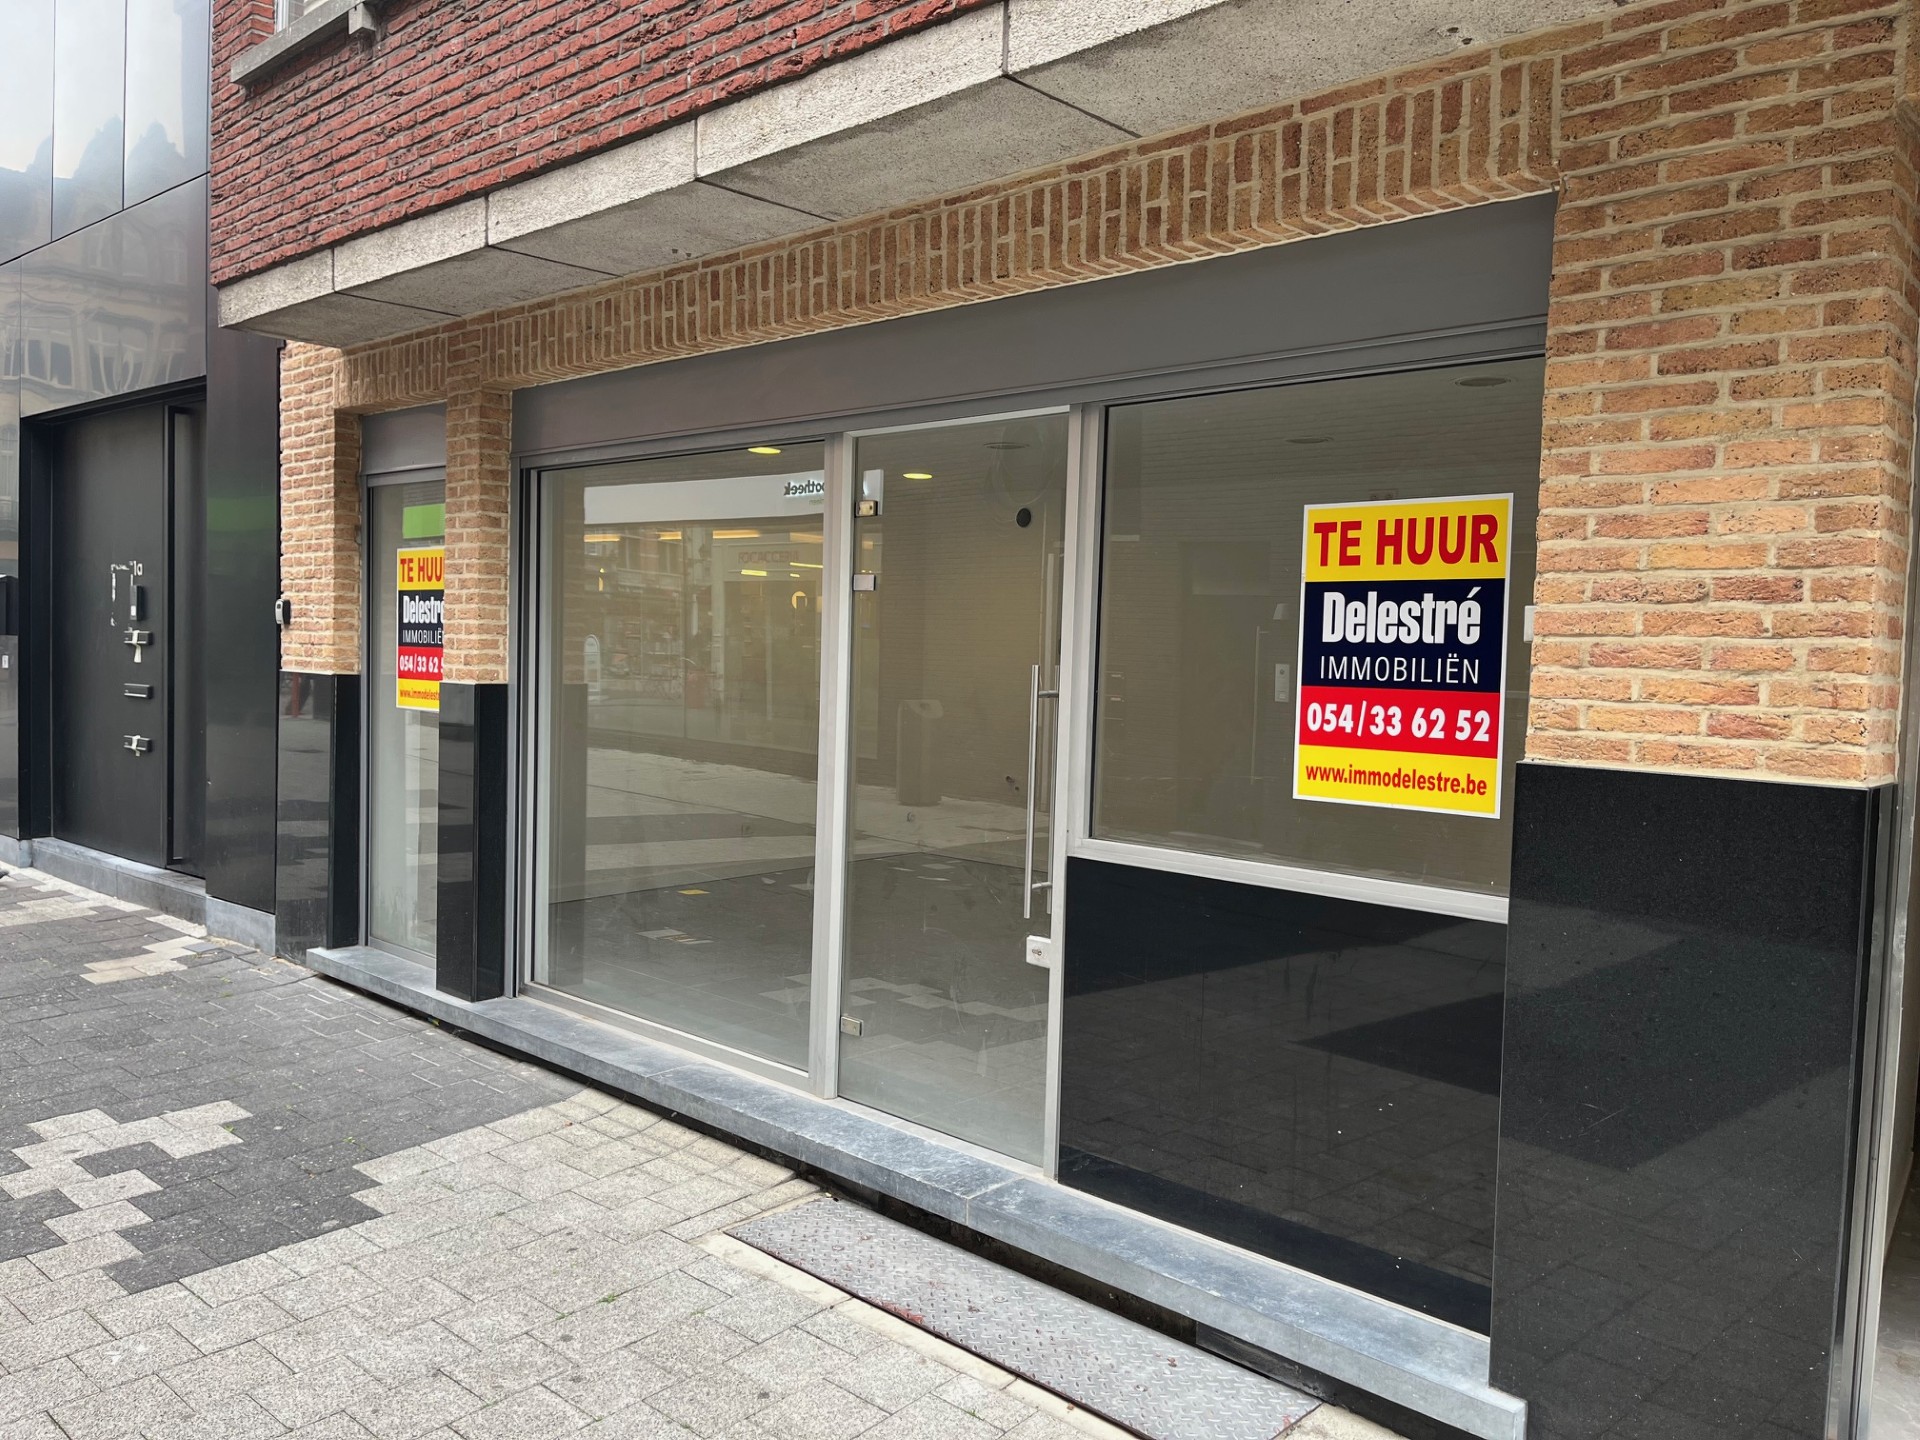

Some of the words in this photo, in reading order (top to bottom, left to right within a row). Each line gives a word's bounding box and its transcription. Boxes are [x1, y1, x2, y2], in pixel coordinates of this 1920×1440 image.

[1313, 520, 1362, 567] TE
[1376, 514, 1499, 566] HUUR
[400, 557, 414, 583] TE
[418, 556, 443, 583] HUU
[1321, 586, 1481, 645] Delestré
[403, 628, 444, 645] IMMOBILIË
[400, 653, 427, 674] 054/33
[428, 656, 439, 674] 62
[1319, 652, 1480, 685] IMMOBILIËN
[1307, 700, 1402, 737] 054/33
[1411, 707, 1446, 739] 62
[1454, 709, 1491, 742] 52
[1305, 763, 1488, 796] www.immodelestre.be
